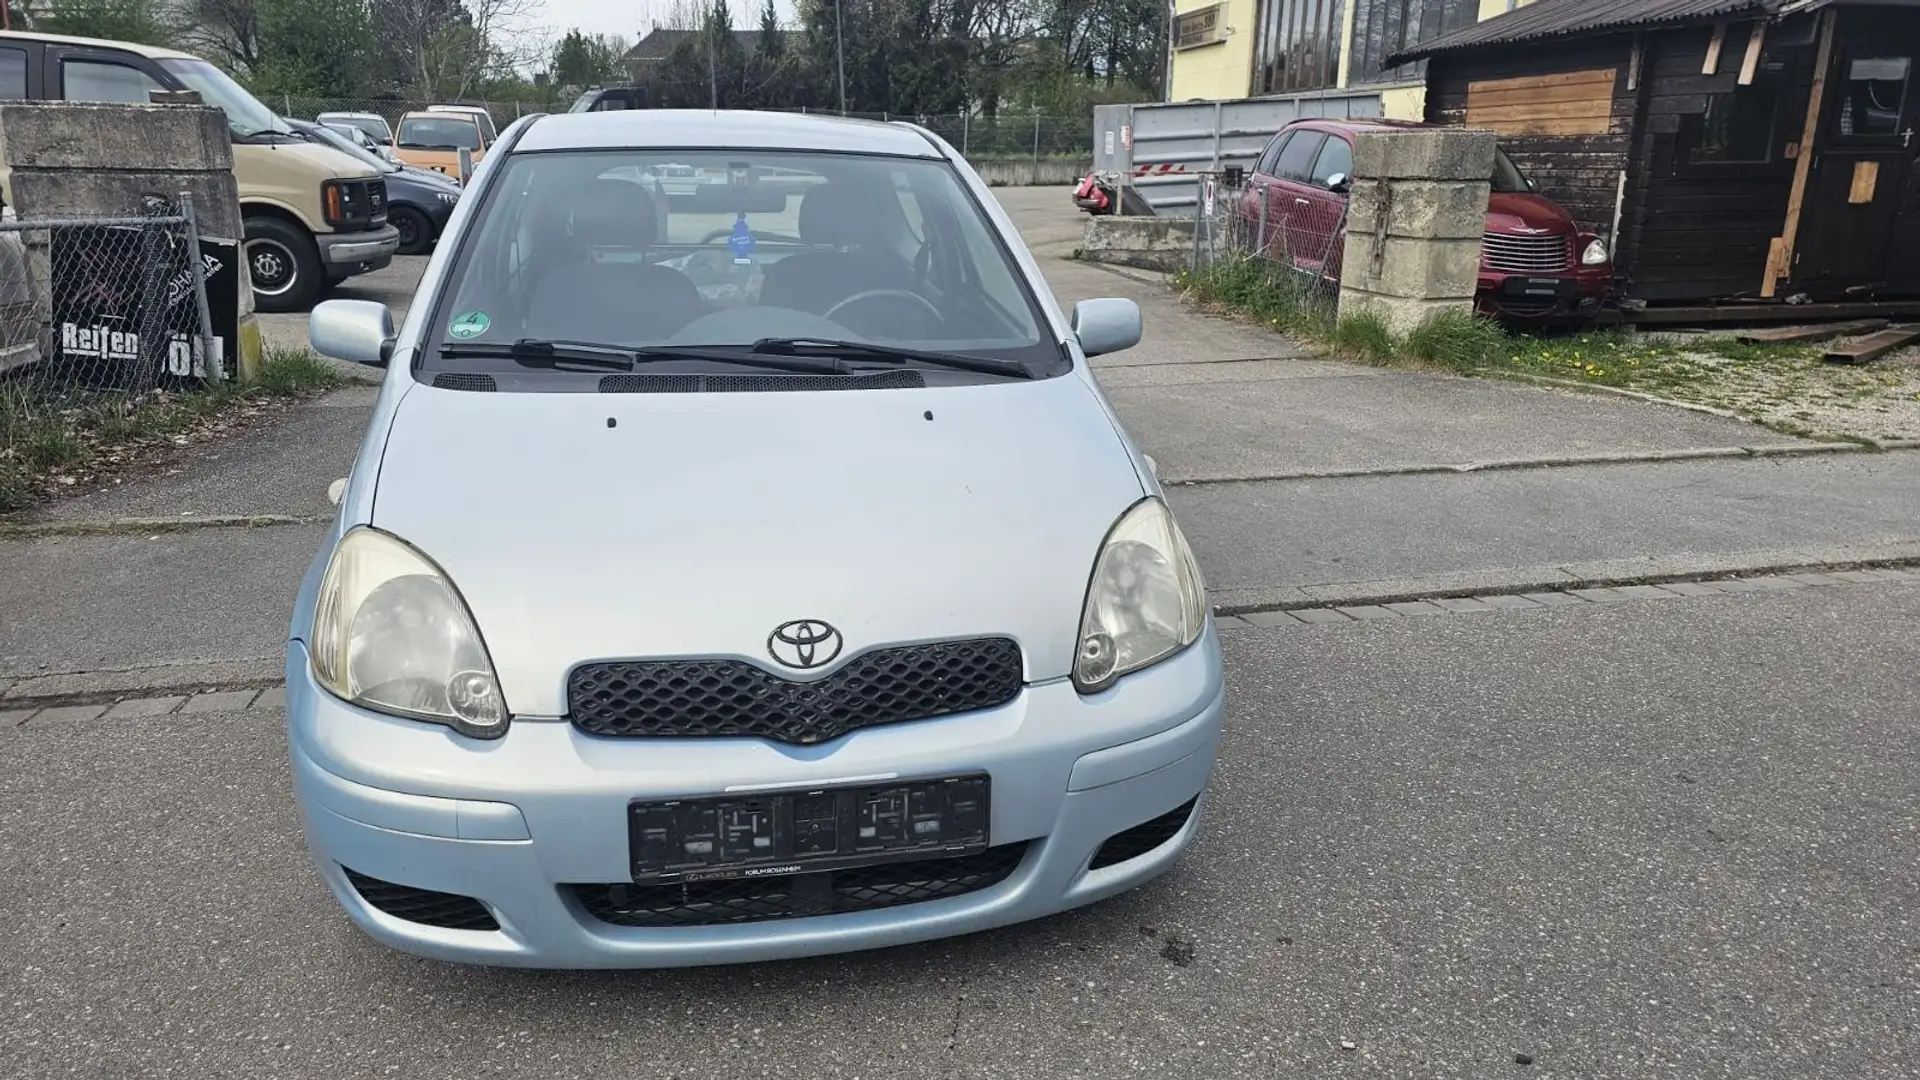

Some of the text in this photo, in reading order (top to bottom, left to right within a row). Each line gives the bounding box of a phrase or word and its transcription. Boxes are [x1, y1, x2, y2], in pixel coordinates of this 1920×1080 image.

[465, 312, 478, 324] 4
[63, 322, 138, 359] Reifen
[745, 867, 767, 876] FORUM
